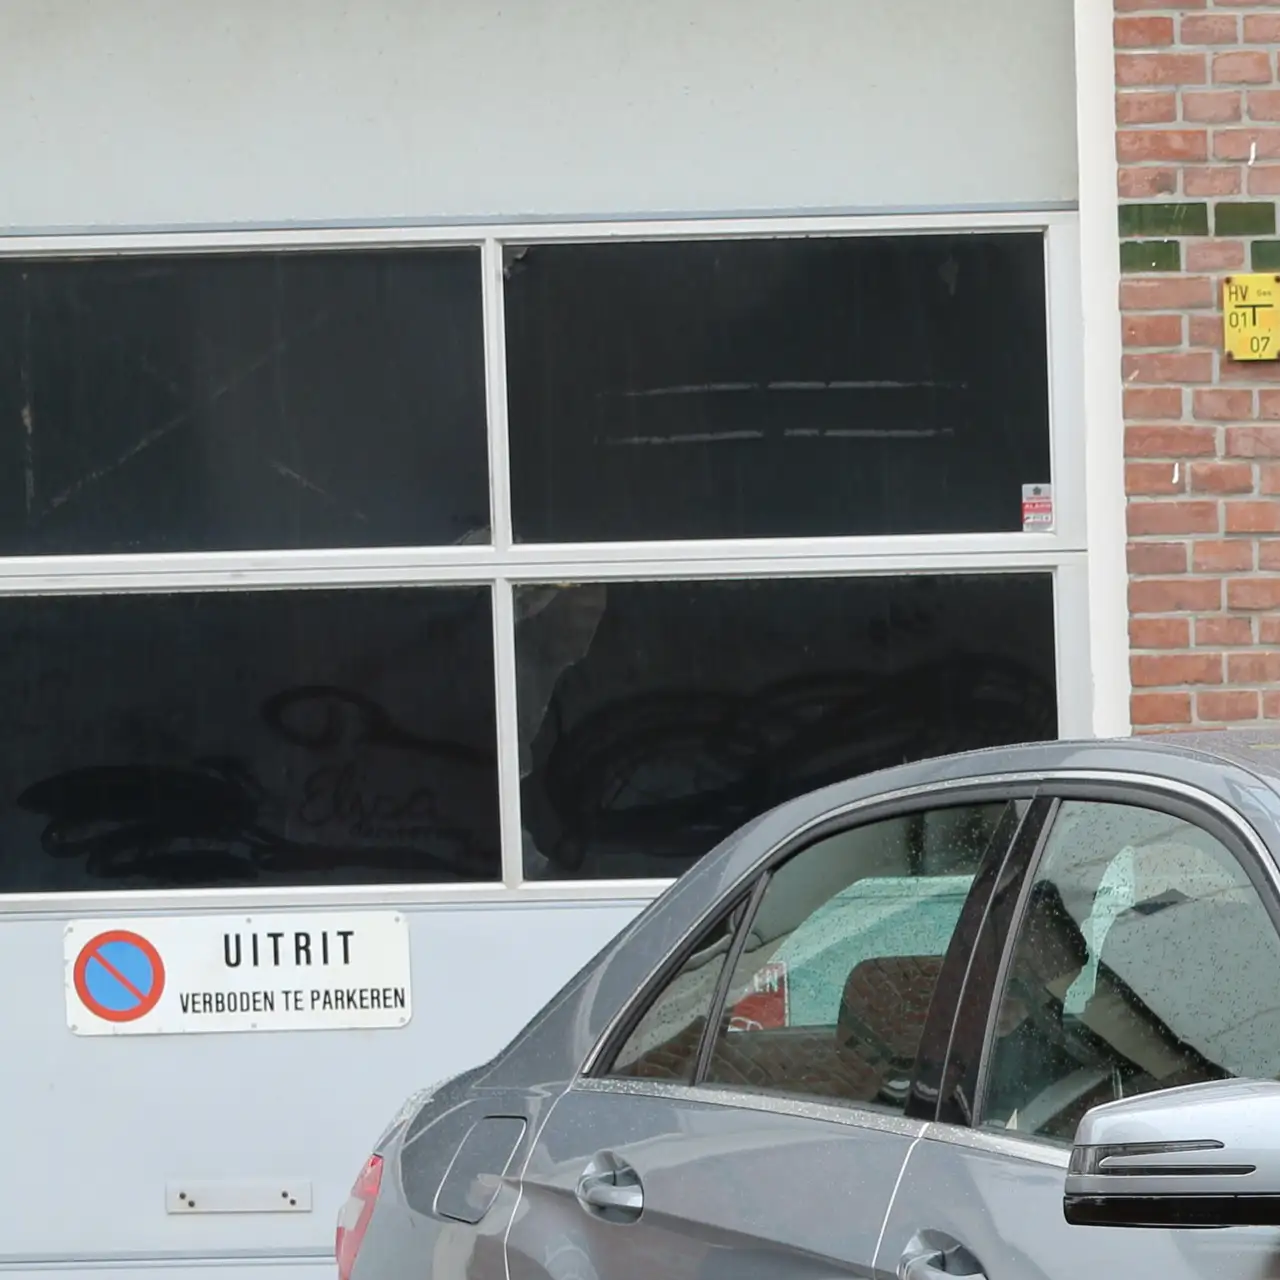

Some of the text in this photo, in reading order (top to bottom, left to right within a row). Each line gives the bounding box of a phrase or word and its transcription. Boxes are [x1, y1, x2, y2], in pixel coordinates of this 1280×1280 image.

[1228, 284, 1248, 302] HV
[1250, 336, 1270, 353] 07
[223, 930, 355, 968] UITRIT
[179, 988, 406, 1014] VERBODEN TE PARKEREN
